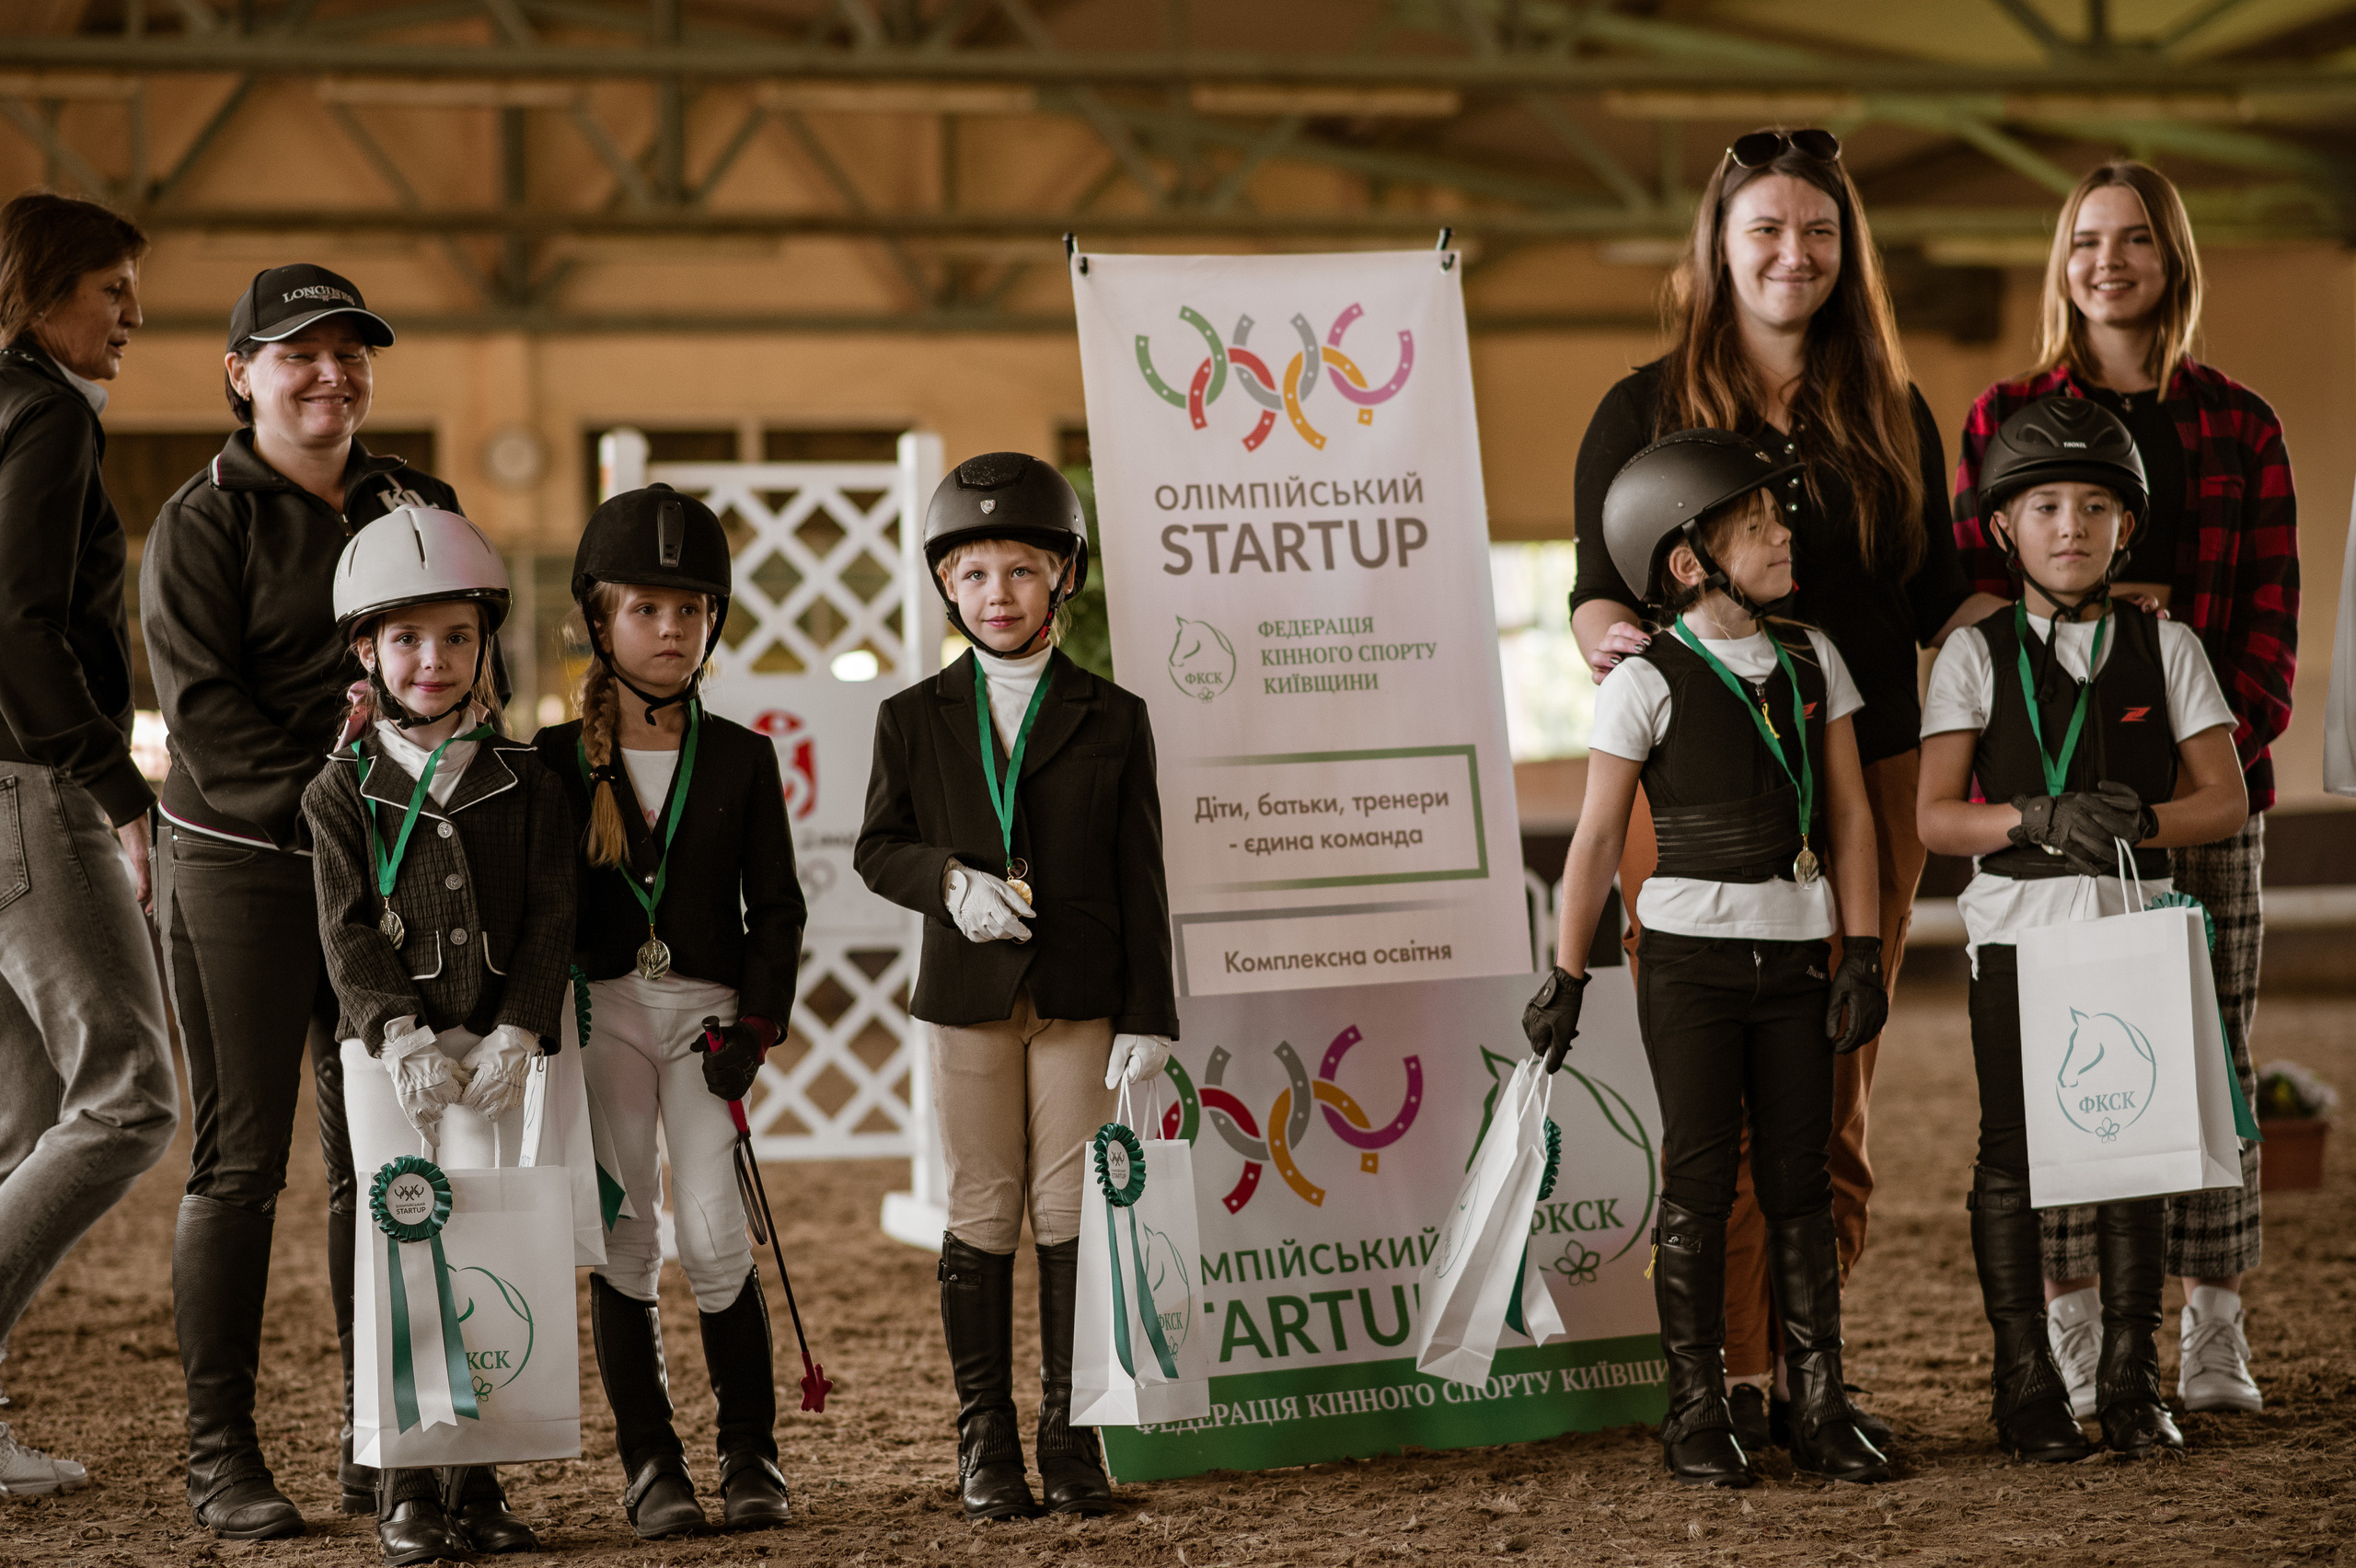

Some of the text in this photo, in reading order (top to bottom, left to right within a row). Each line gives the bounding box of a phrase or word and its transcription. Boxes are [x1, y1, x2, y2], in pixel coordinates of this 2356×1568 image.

[1155, 470, 1425, 511] ОЛІМПІЙСЬКИЙ
[1161, 517, 1428, 576] STARTUP
[1257, 616, 1374, 640] ФЕДЕРАЦІЯ
[1261, 642, 1438, 666] КІННОГО СПОРТУ
[1184, 672, 1223, 685] ФКСК
[1264, 673, 1379, 695] КИЇВЩИНИ
[1195, 791, 1449, 823] Діти, батьки, тренери
[1244, 834, 1313, 856] єдина
[1321, 828, 1423, 848] команда
[1224, 940, 1452, 974] Комплексна освітня
[2078, 1090, 2136, 1113] ФКСК
[396, 1206, 426, 1215] STARTUP
[1200, 1227, 1440, 1286] МПІЙСЬКИЙ
[1204, 1283, 1420, 1363] ARTU
[466, 1350, 512, 1370] КСК
[1305, 1382, 1435, 1418] КІННОГО
[1558, 1358, 1669, 1392] КИЇВЩИ
